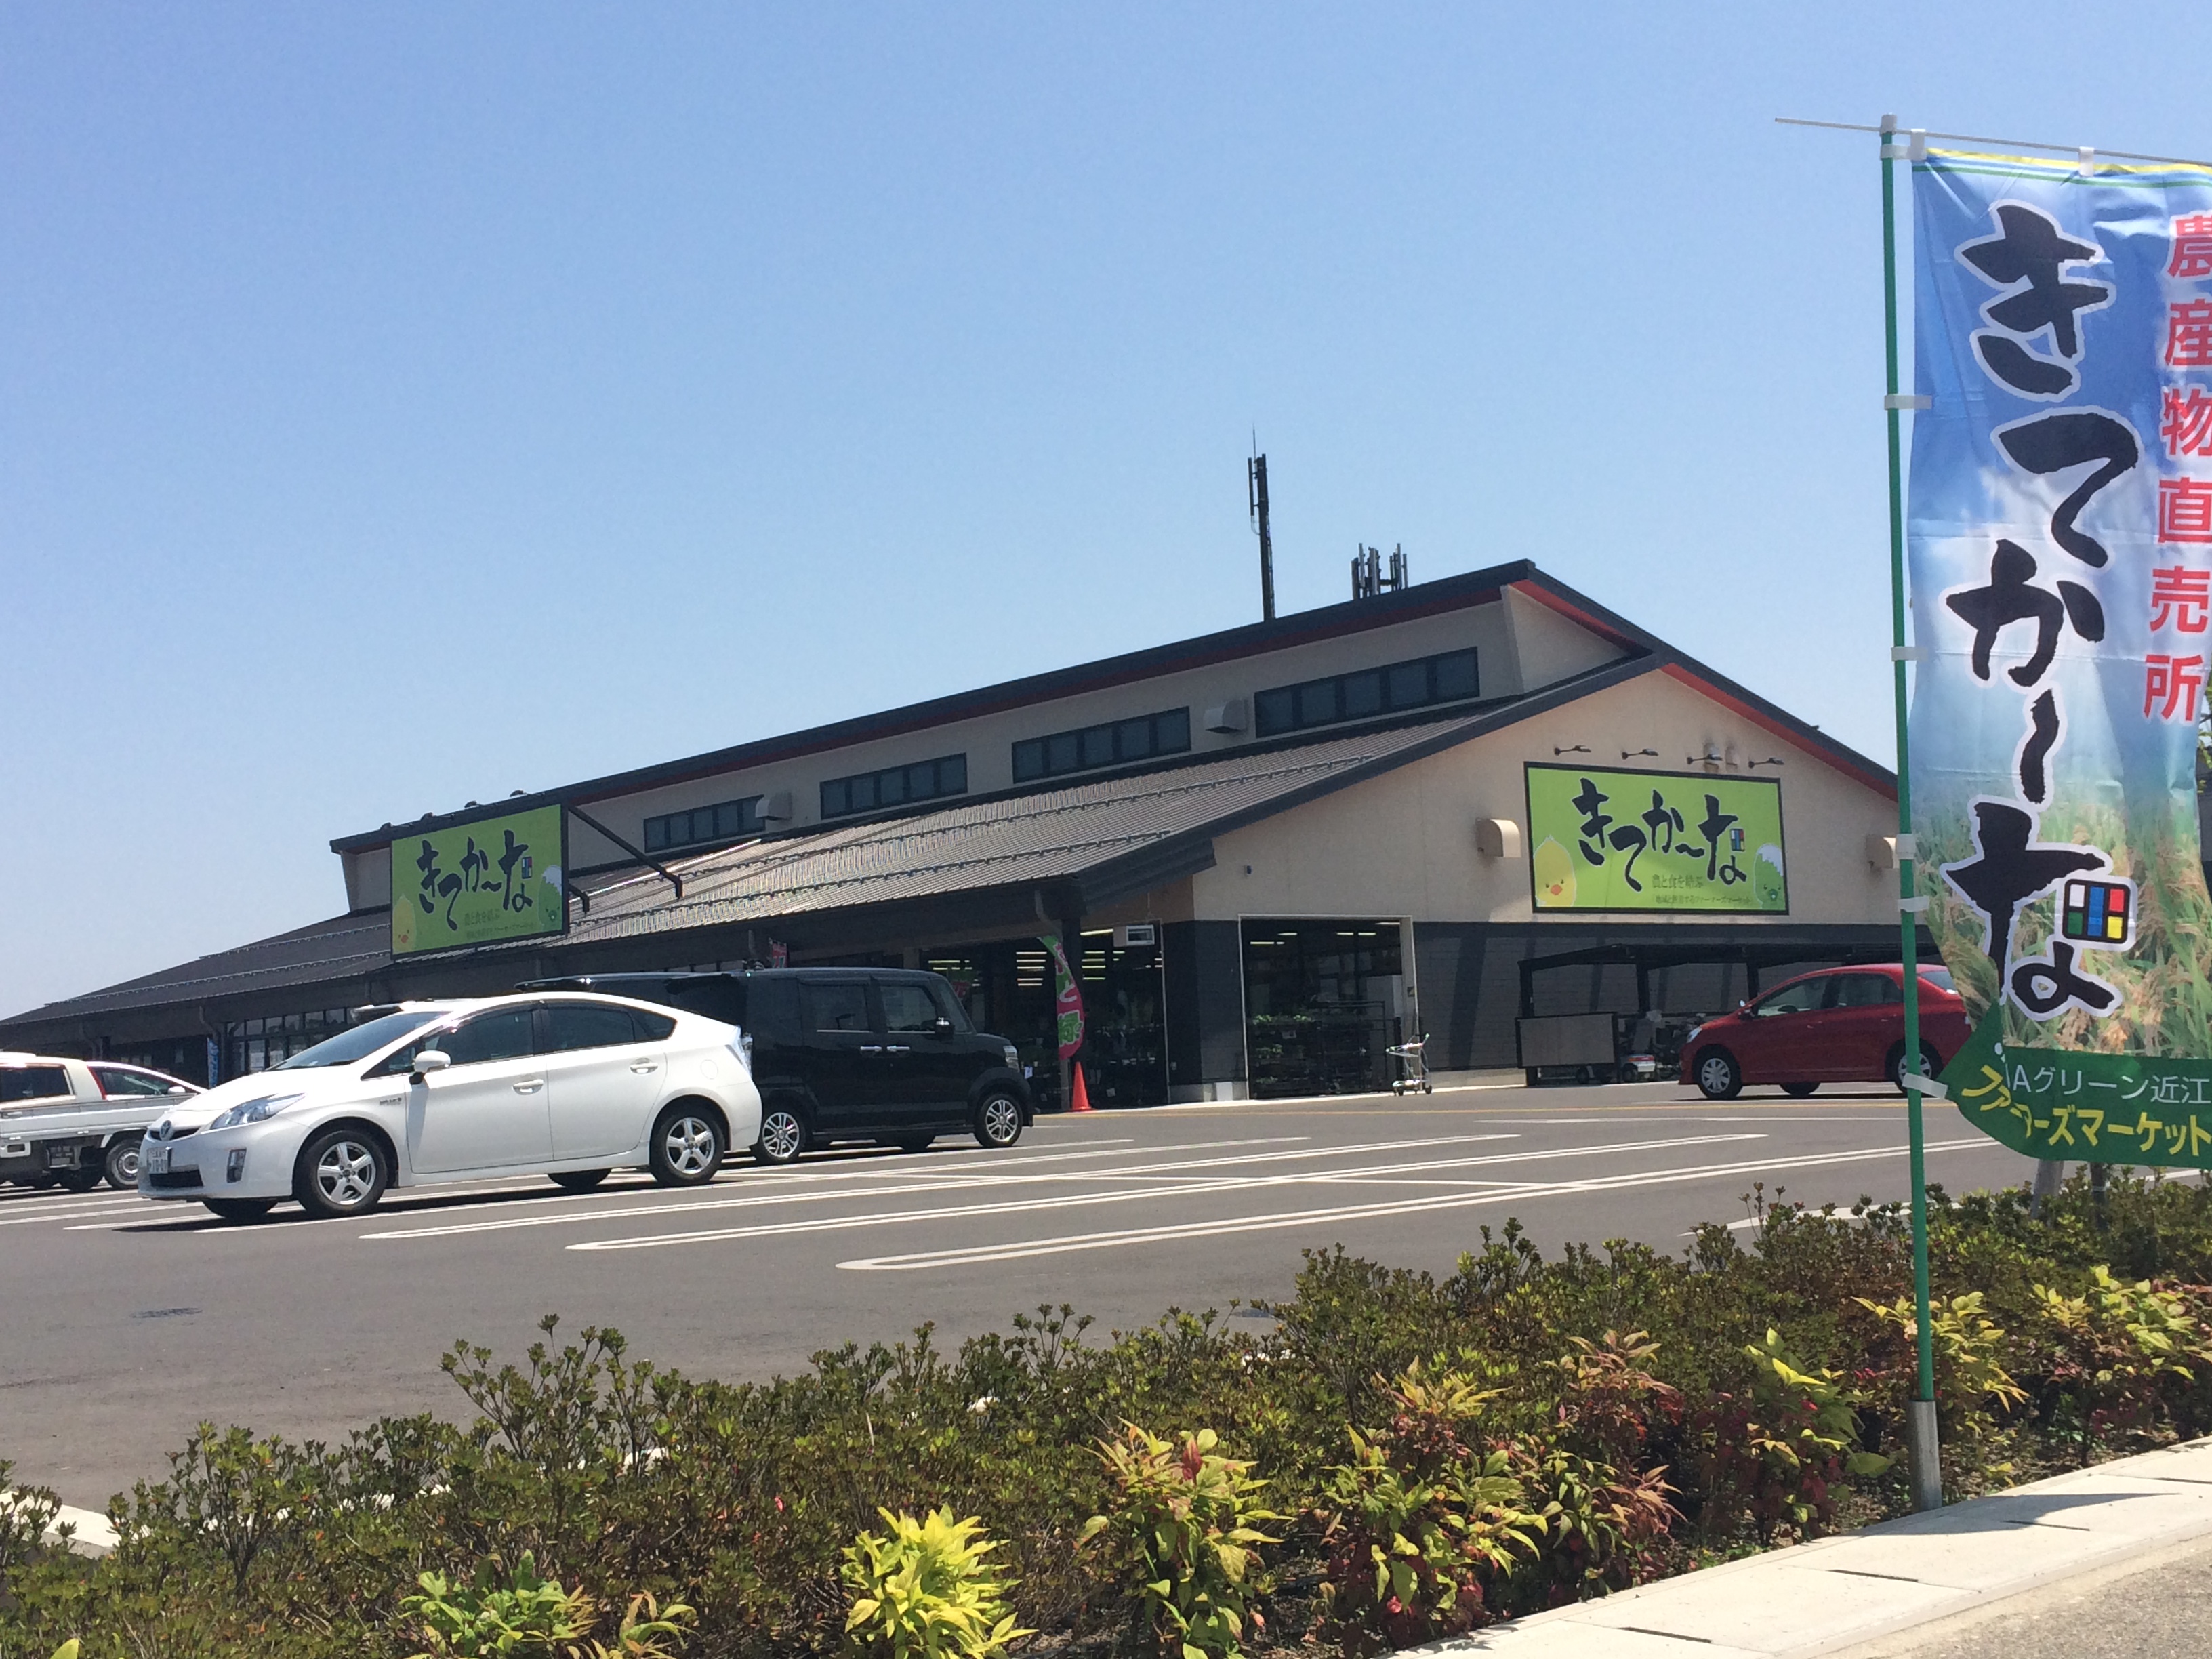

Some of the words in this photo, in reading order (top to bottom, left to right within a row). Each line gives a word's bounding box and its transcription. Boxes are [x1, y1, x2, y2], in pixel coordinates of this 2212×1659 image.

[2143, 215, 2212, 722] 農産物直売所
